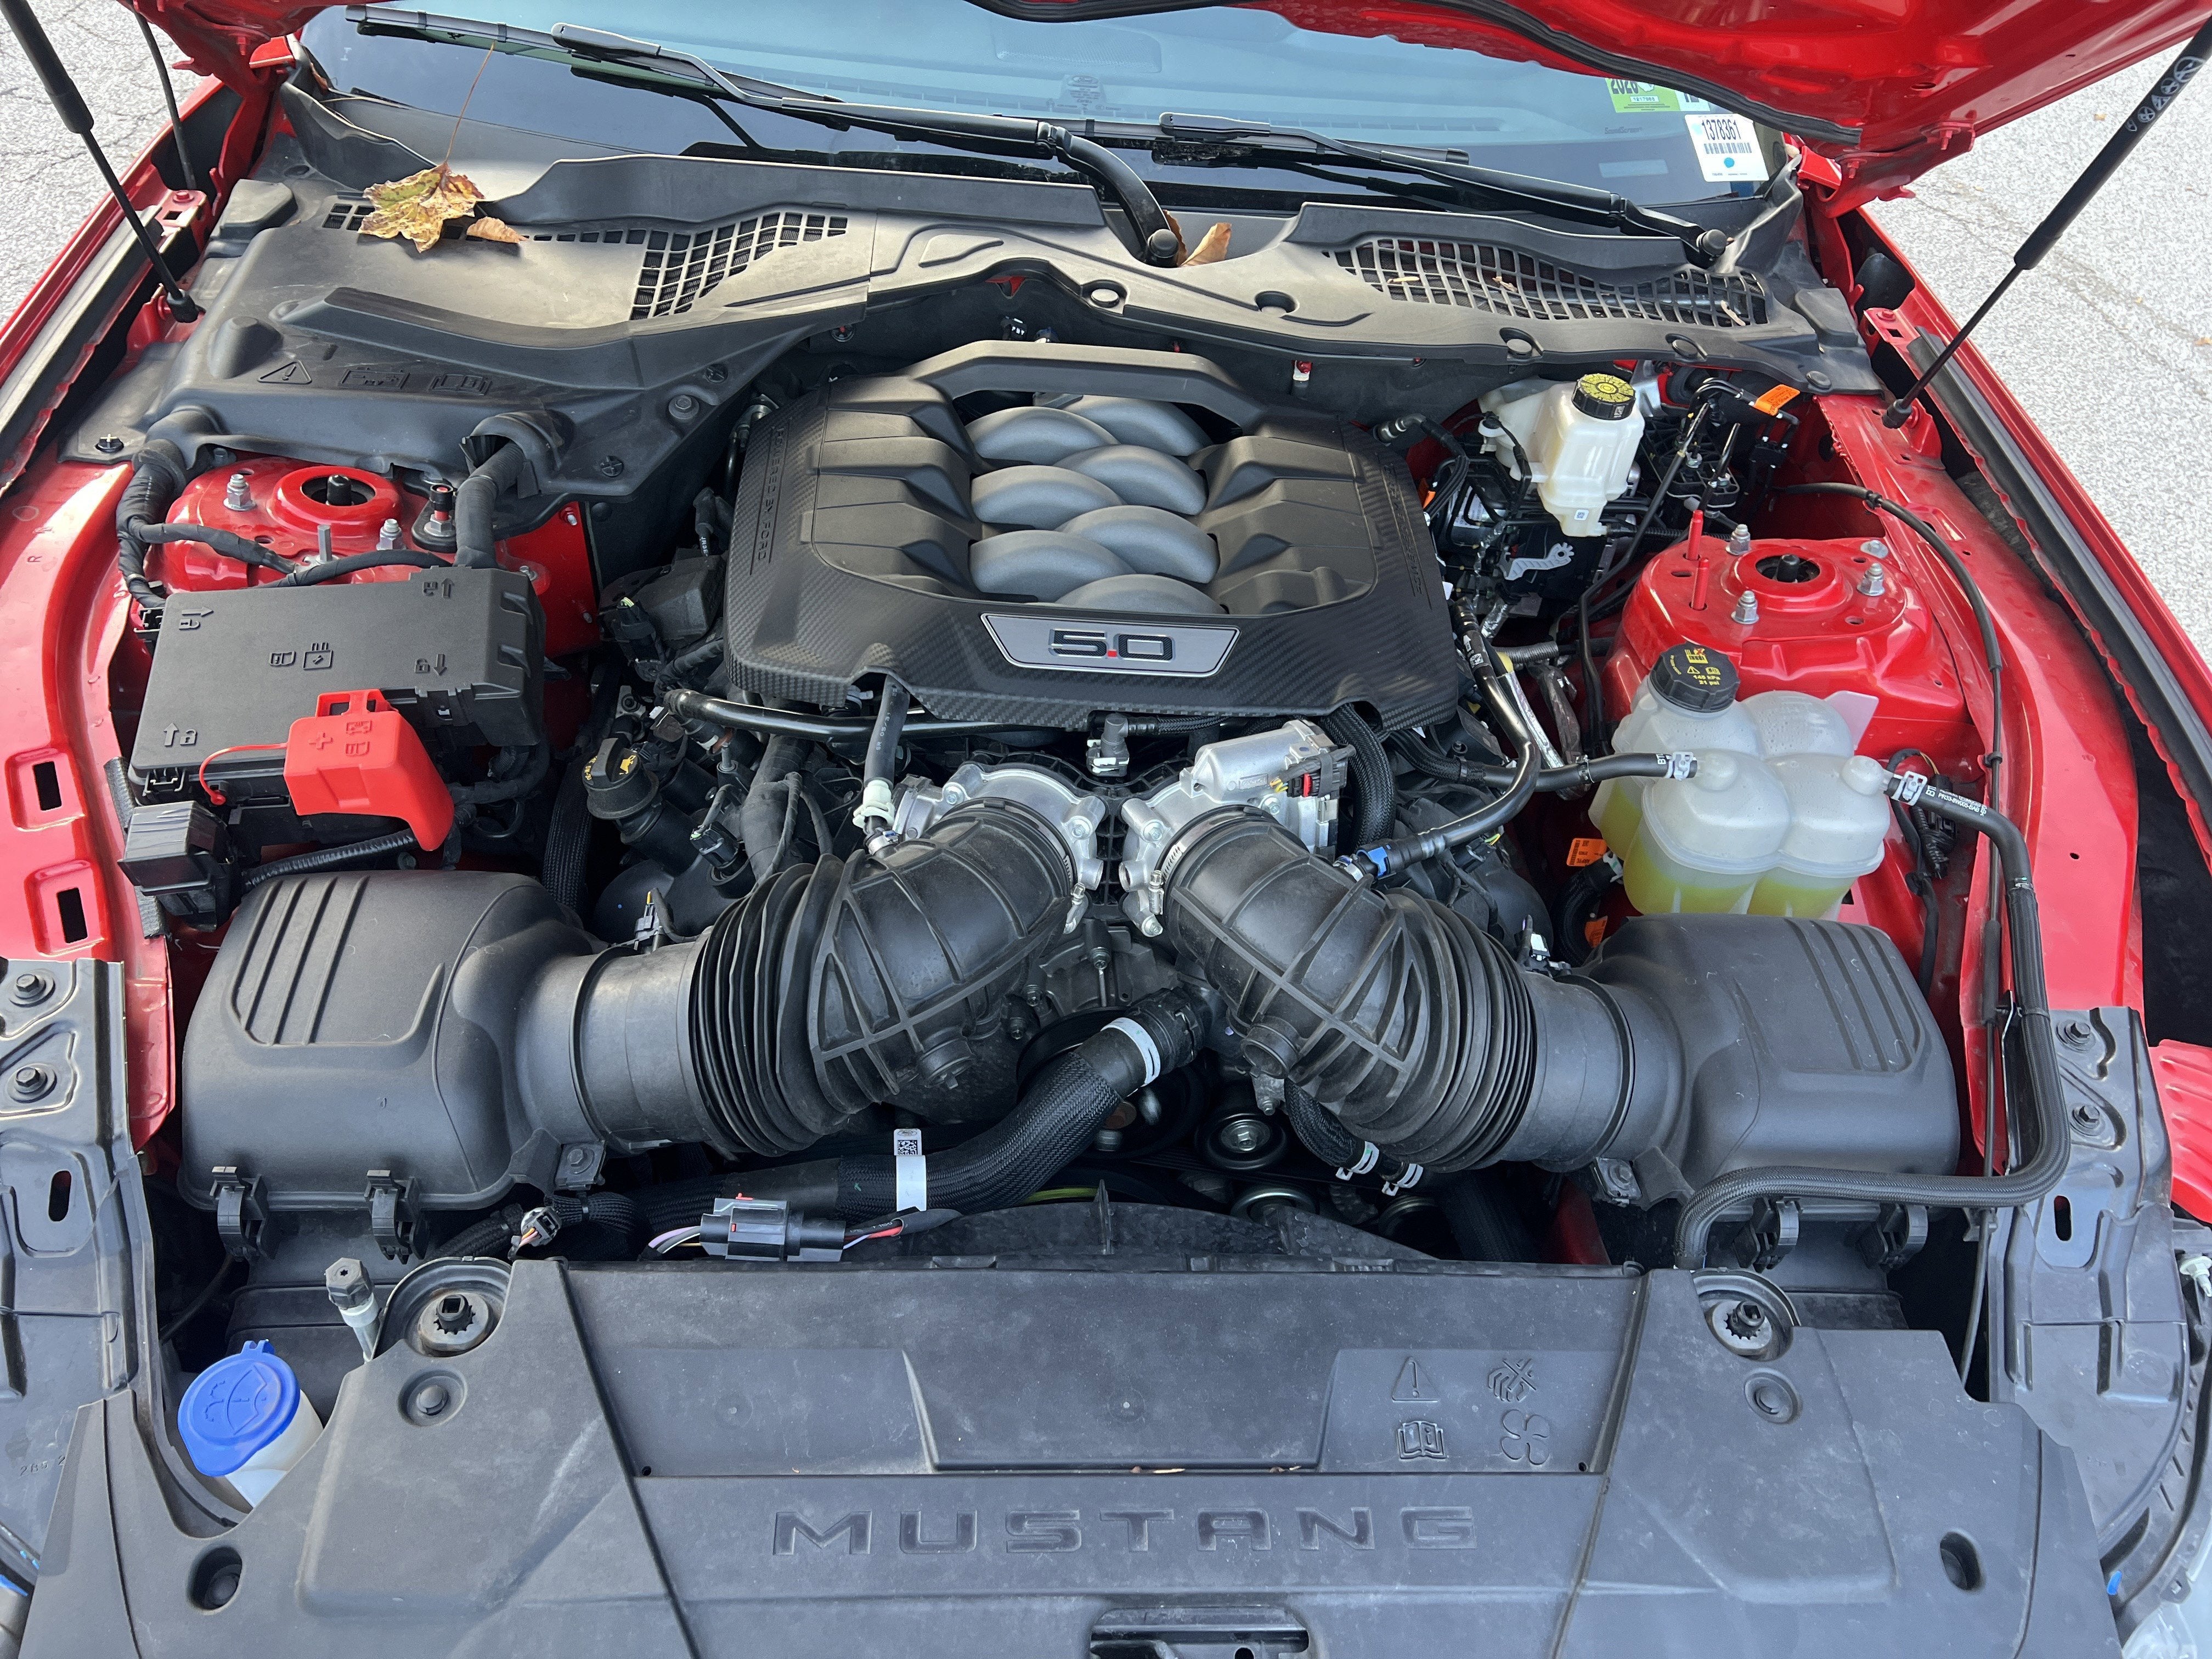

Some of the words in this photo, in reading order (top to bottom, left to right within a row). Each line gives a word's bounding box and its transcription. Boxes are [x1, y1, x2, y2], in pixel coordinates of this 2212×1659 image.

[1702, 119, 1741, 140] 1378361
[765, 498, 774, 514] BY
[757, 521, 771, 561] FORD
[1048, 628, 1176, 663] 5.0
[772, 1505, 1477, 1556] MUSTANG
